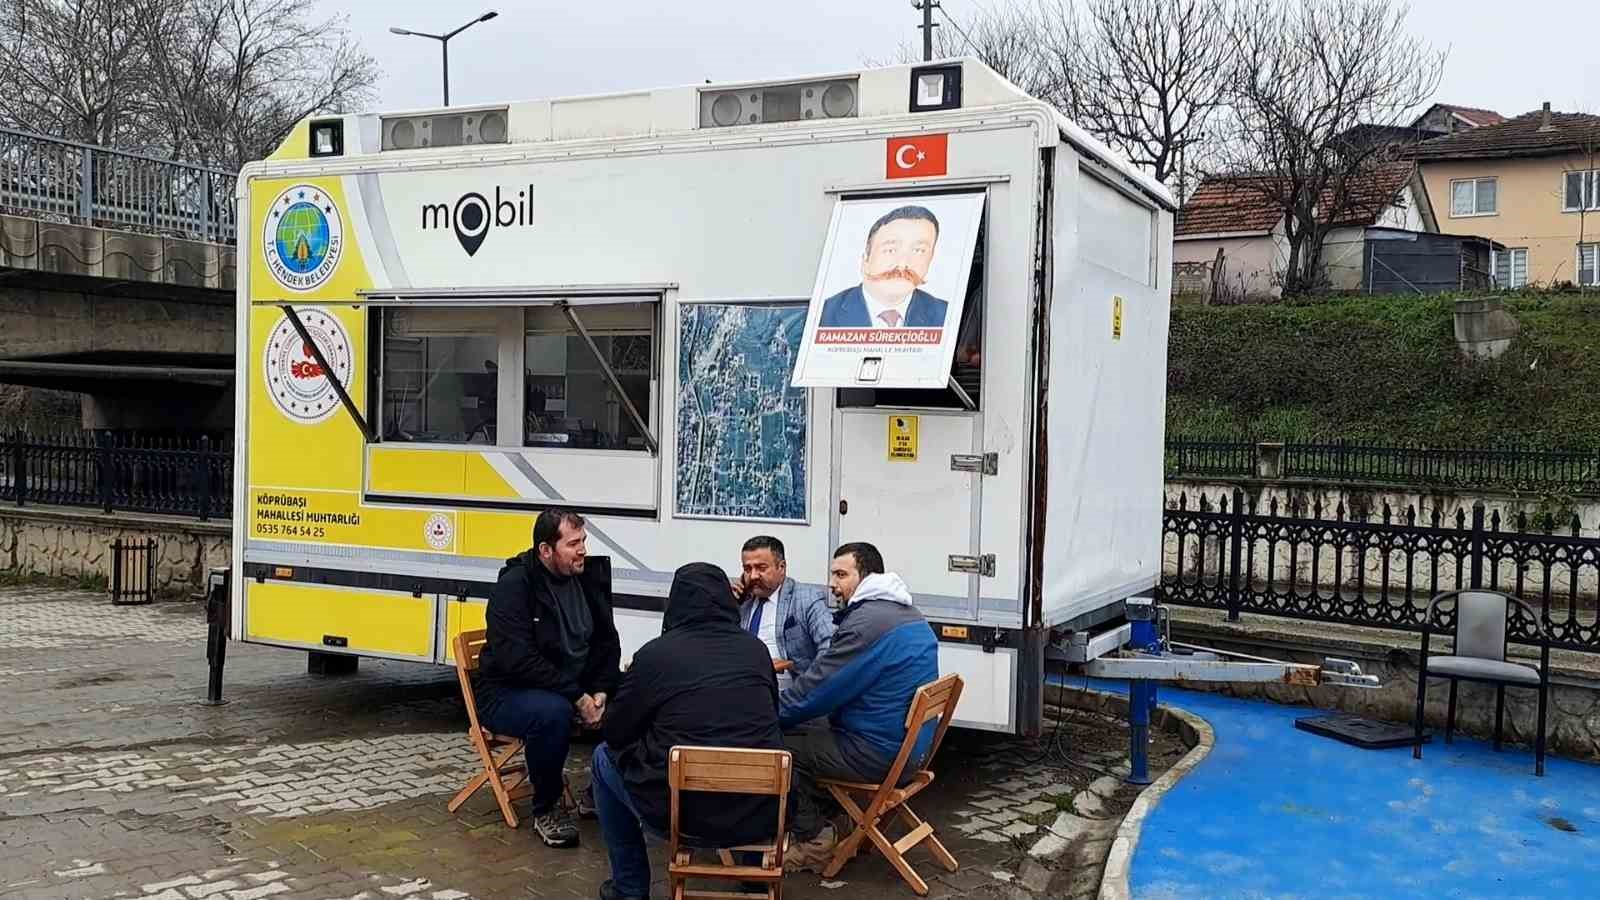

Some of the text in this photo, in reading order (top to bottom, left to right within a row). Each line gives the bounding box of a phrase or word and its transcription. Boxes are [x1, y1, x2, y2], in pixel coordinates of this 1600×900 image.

[422, 184, 534, 257] mobil
[271, 257, 304, 286] HENDEK
[819, 329, 938, 344] RAMAZAN SÜREKÇİOĞLU
[256, 492, 307, 508] KÖPRÜBAŞI
[256, 509, 361, 526] MAHALLESİ MUHTARLIĞI
[256, 523, 325, 538] 0535 764 54 25
